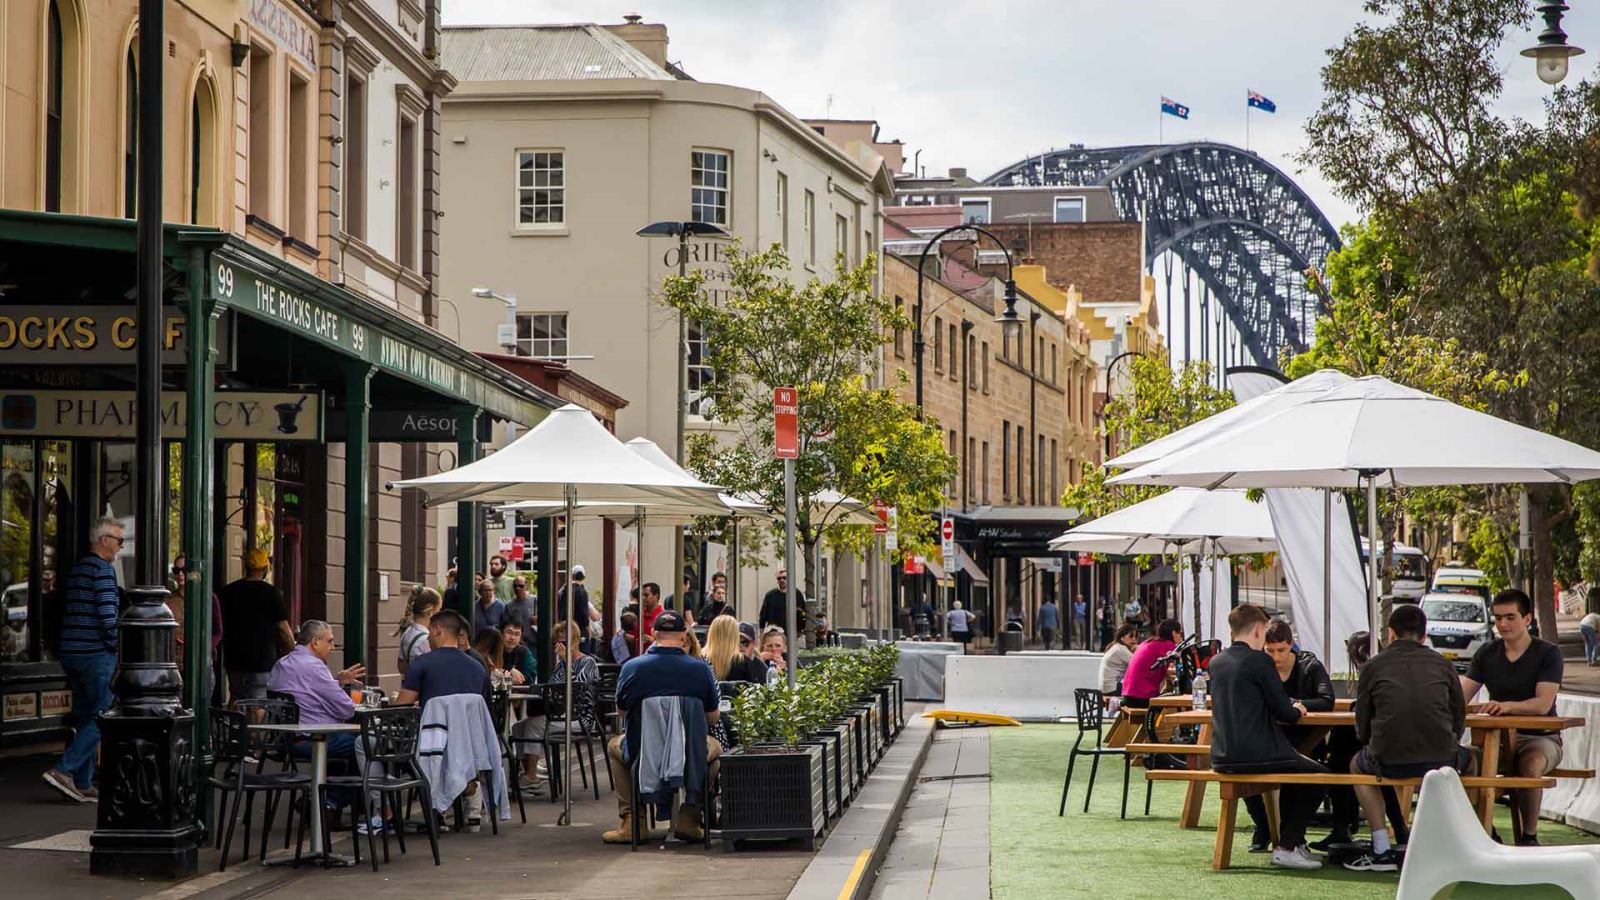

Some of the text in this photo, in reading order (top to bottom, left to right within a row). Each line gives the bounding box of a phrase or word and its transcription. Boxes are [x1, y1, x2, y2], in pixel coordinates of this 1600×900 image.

[218, 264, 233, 298] 99
[255, 279, 339, 341] THE ROCKS CAFE
[0, 316, 187, 349] OCKS CF
[352, 323, 365, 351] 99
[775, 405, 797, 415] STOPPING
[780, 391, 791, 402] NO
[56, 399, 260, 426] PHAMCY
